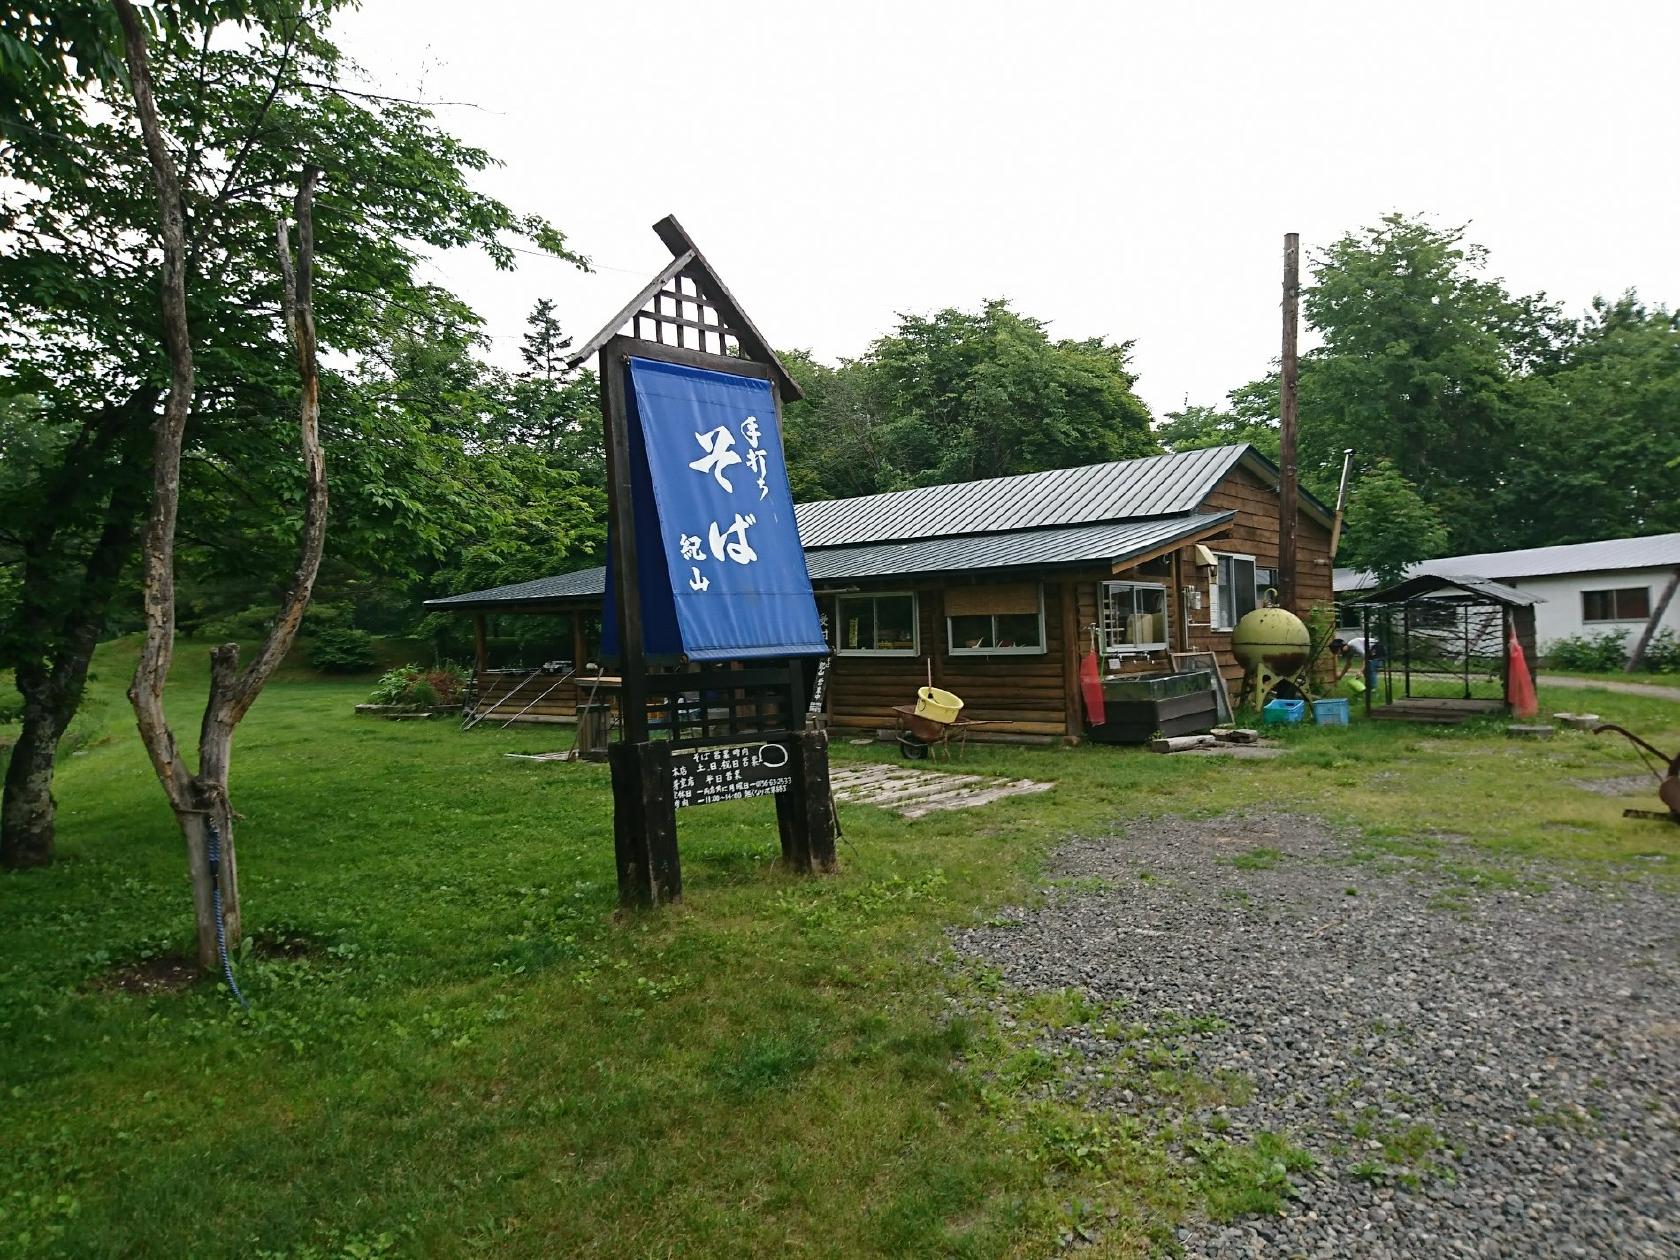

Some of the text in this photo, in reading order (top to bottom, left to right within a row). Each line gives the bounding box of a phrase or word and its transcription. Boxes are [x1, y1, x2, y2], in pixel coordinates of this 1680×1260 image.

[689, 425, 758, 565] そば
[741, 416, 769, 501] 手打ち
[680, 533, 711, 591] 紀山
